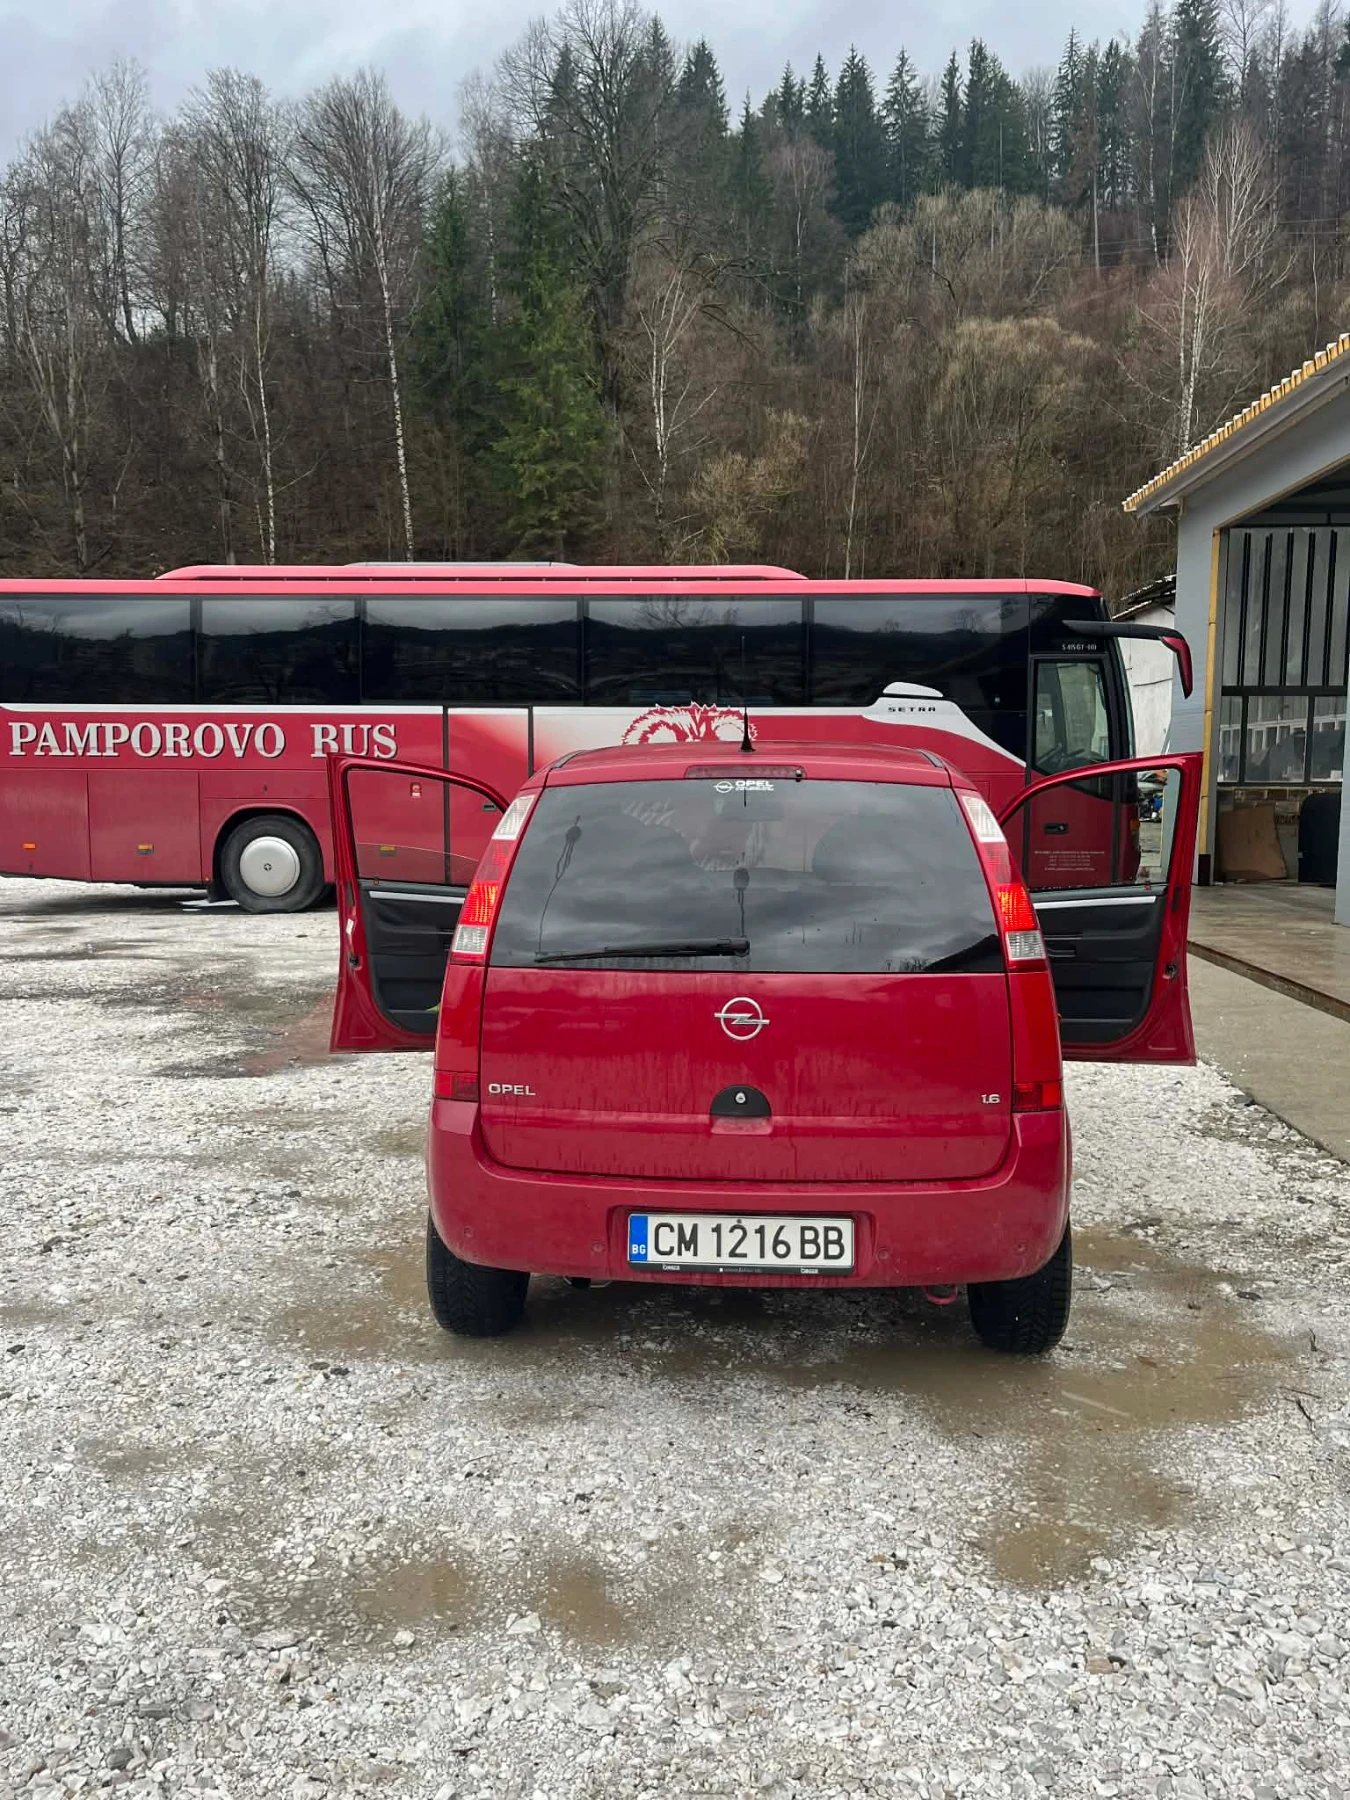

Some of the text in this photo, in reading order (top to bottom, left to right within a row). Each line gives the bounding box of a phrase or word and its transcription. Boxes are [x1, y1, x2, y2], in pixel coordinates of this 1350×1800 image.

[8, 721, 399, 758] PAMPOROVO BUS
[735, 780, 775, 788] OPEL
[488, 1083, 537, 1096] OPEL
[654, 1222, 845, 1260] CM 1216 BB
[631, 1243, 646, 1255] BG
